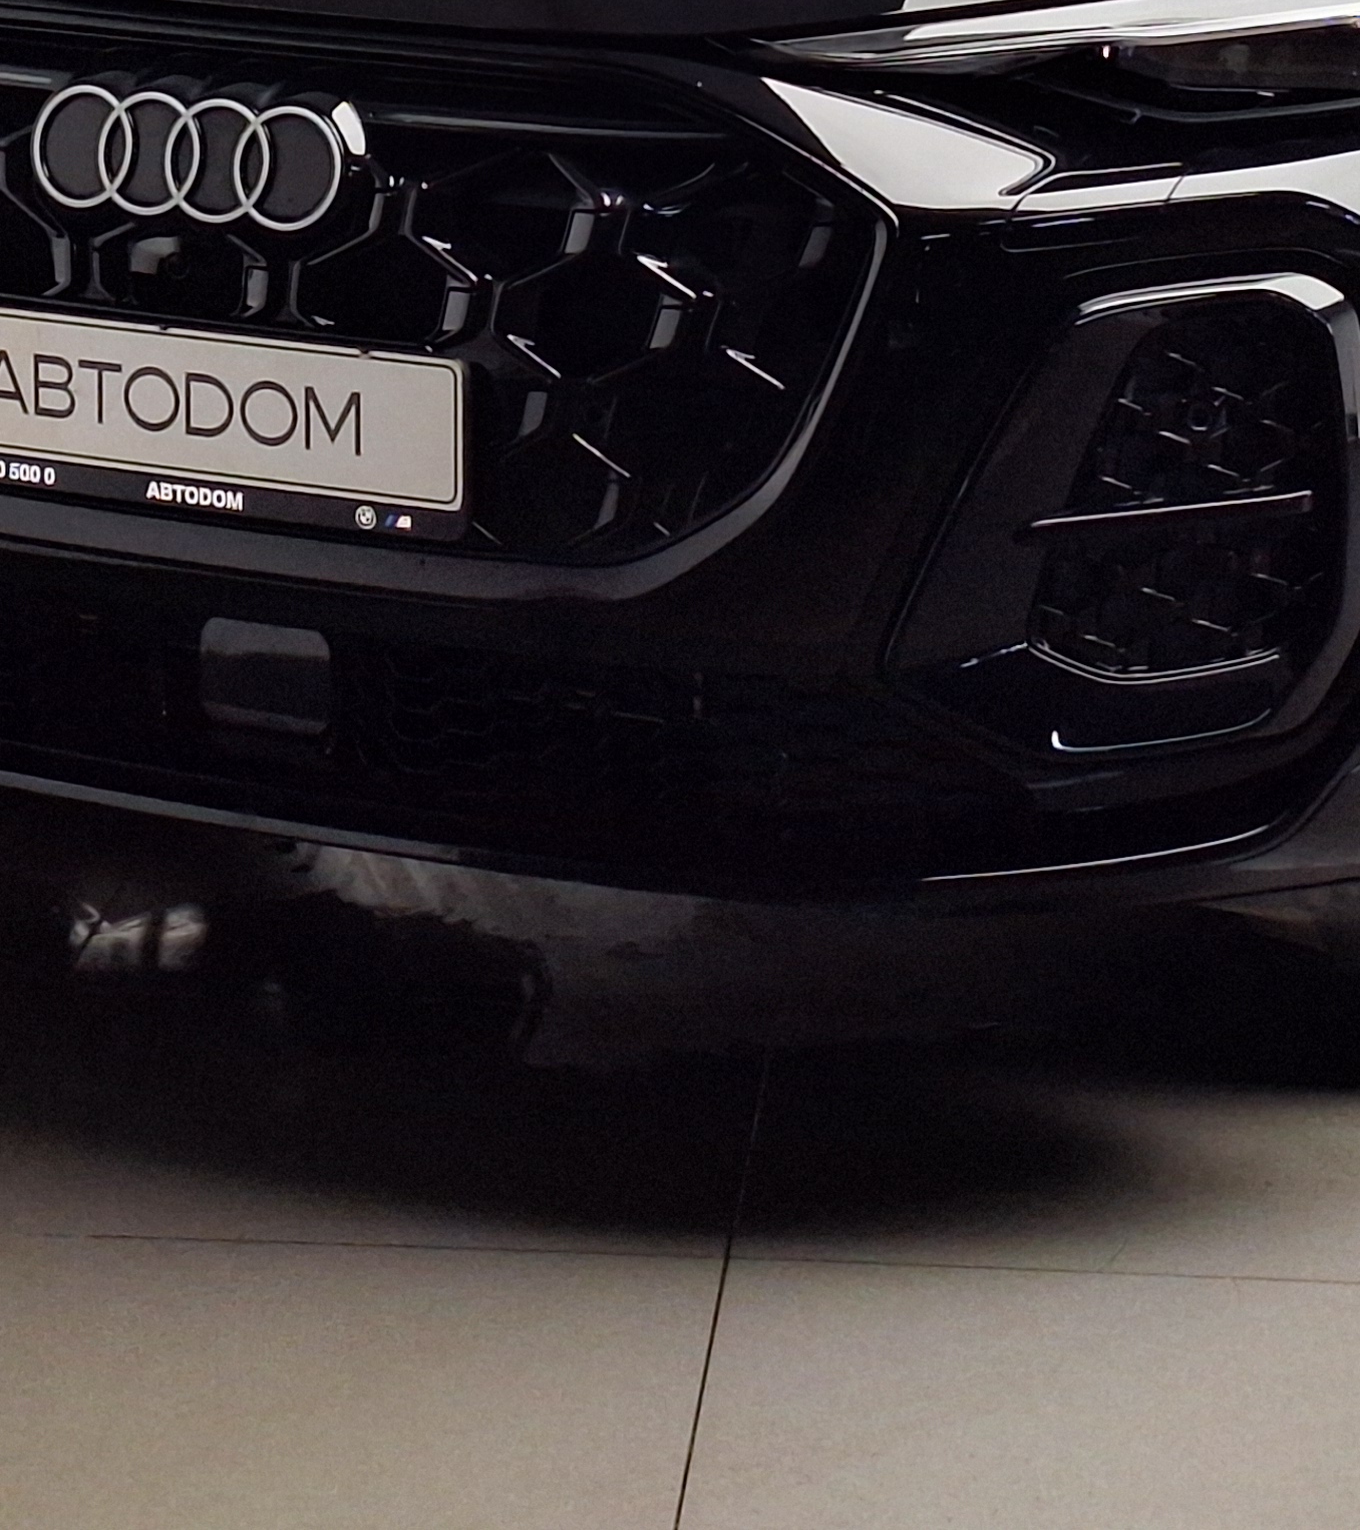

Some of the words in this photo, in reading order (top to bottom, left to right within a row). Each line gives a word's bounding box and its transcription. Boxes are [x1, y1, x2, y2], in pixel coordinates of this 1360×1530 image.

[8, 462, 41, 483] 500
[43, 467, 56, 486] 0
[146, 481, 243, 511] ABTODOM
